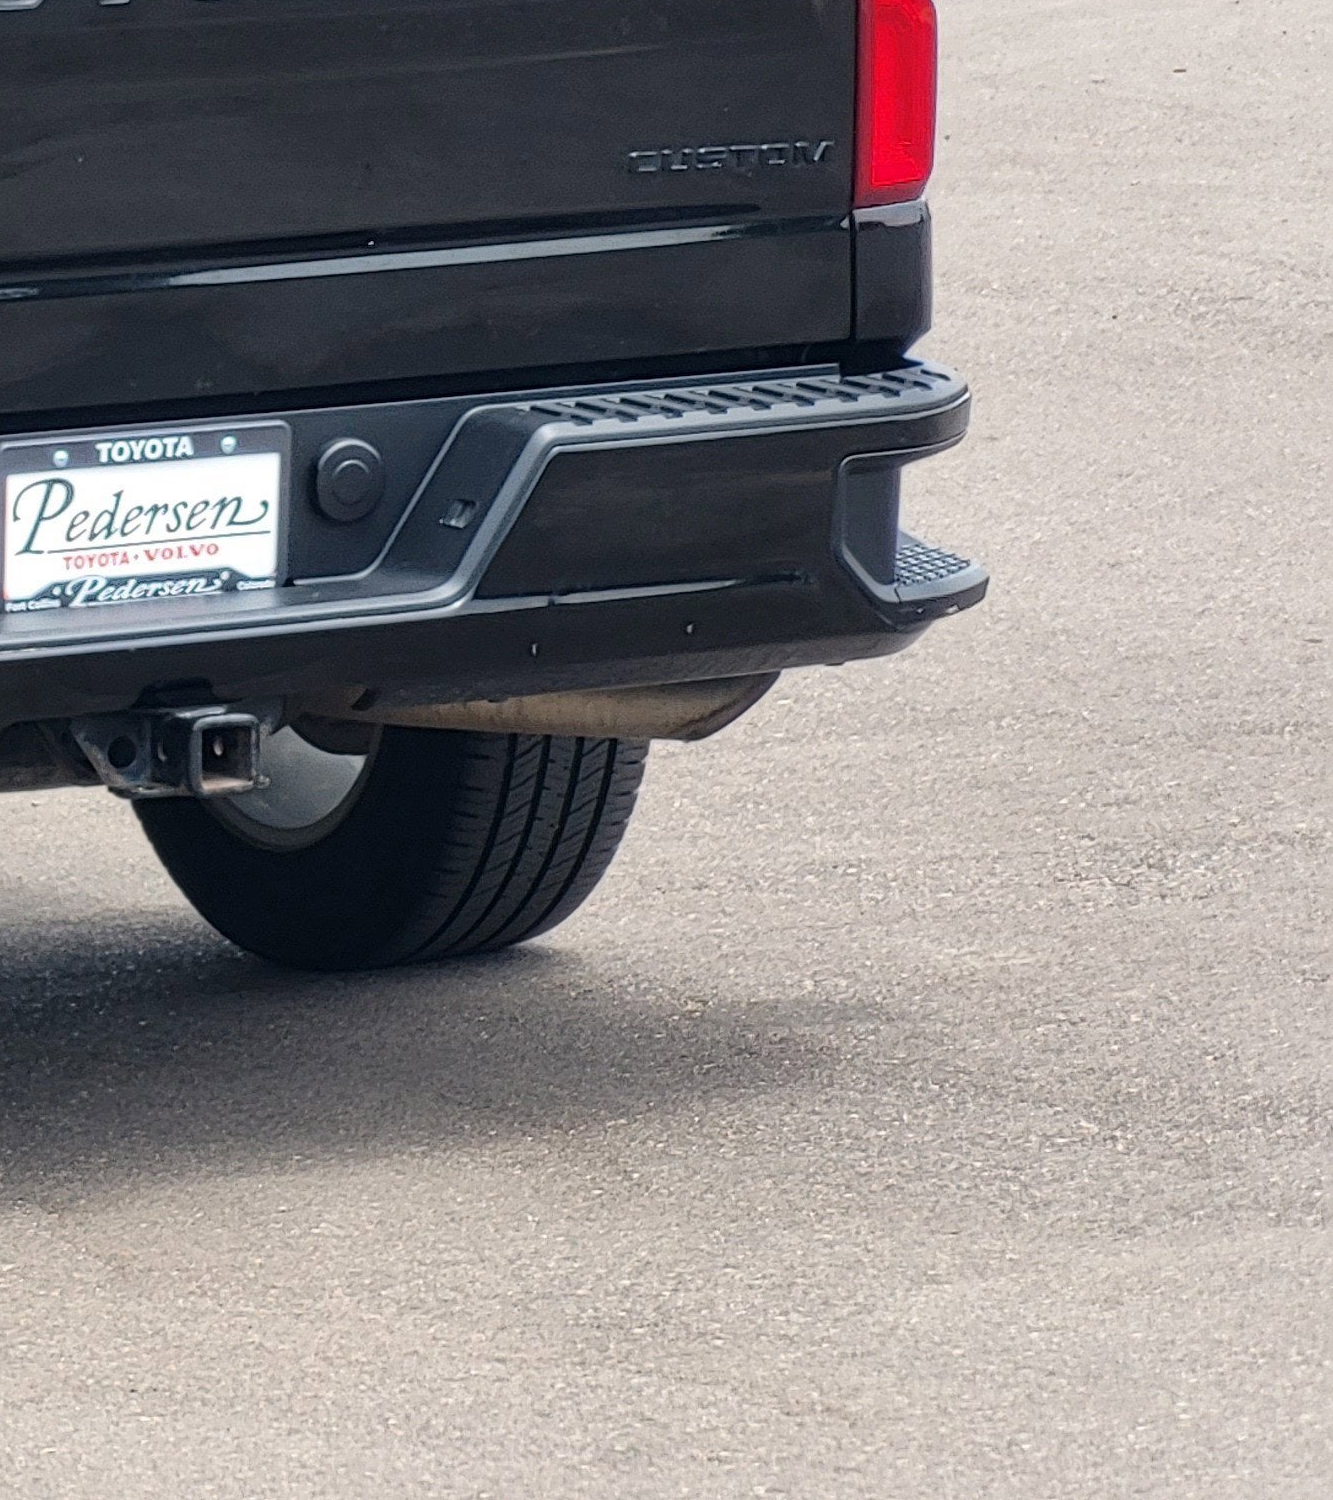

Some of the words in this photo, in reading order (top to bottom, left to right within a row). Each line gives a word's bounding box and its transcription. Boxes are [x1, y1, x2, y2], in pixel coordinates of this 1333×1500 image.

[627, 140, 834, 174] CUSTOM
[94, 435, 194, 464] TOYOTA
[12, 477, 270, 556] Pedersen
[62, 551, 130, 572] TOYOTA
[144, 542, 220, 563] VOLVO
[65, 573, 223, 607] Pedersen
